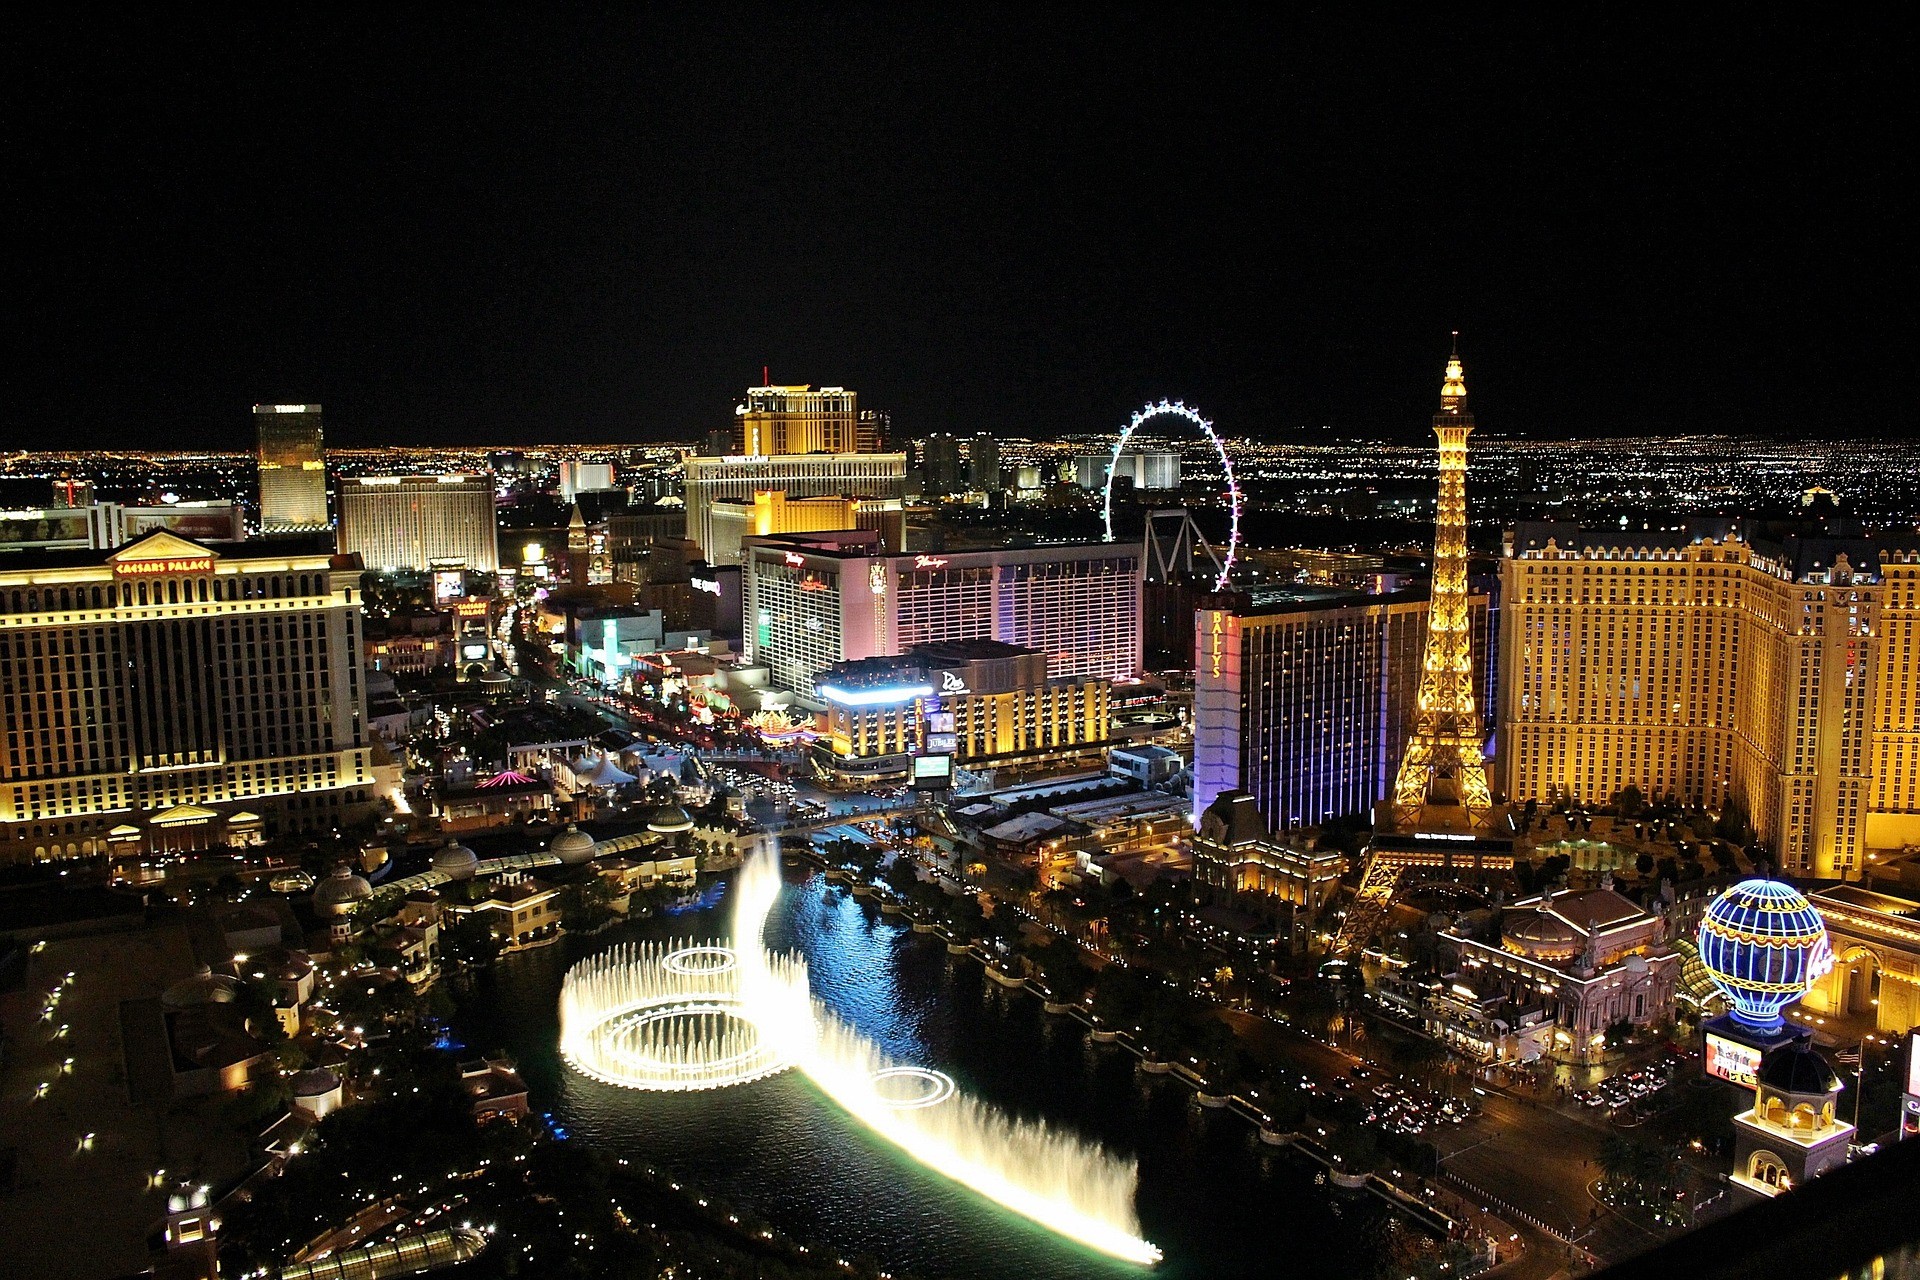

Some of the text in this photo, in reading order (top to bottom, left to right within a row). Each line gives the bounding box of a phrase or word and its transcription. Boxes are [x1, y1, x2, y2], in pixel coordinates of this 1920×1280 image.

[274, 404, 306, 414] TRUMP
[116, 559, 210, 574] CAESARS PALACE
[914, 555, 948, 569] Flamingo
[457, 602, 487, 610] CAESARS
[459, 608, 486, 616] PALACE
